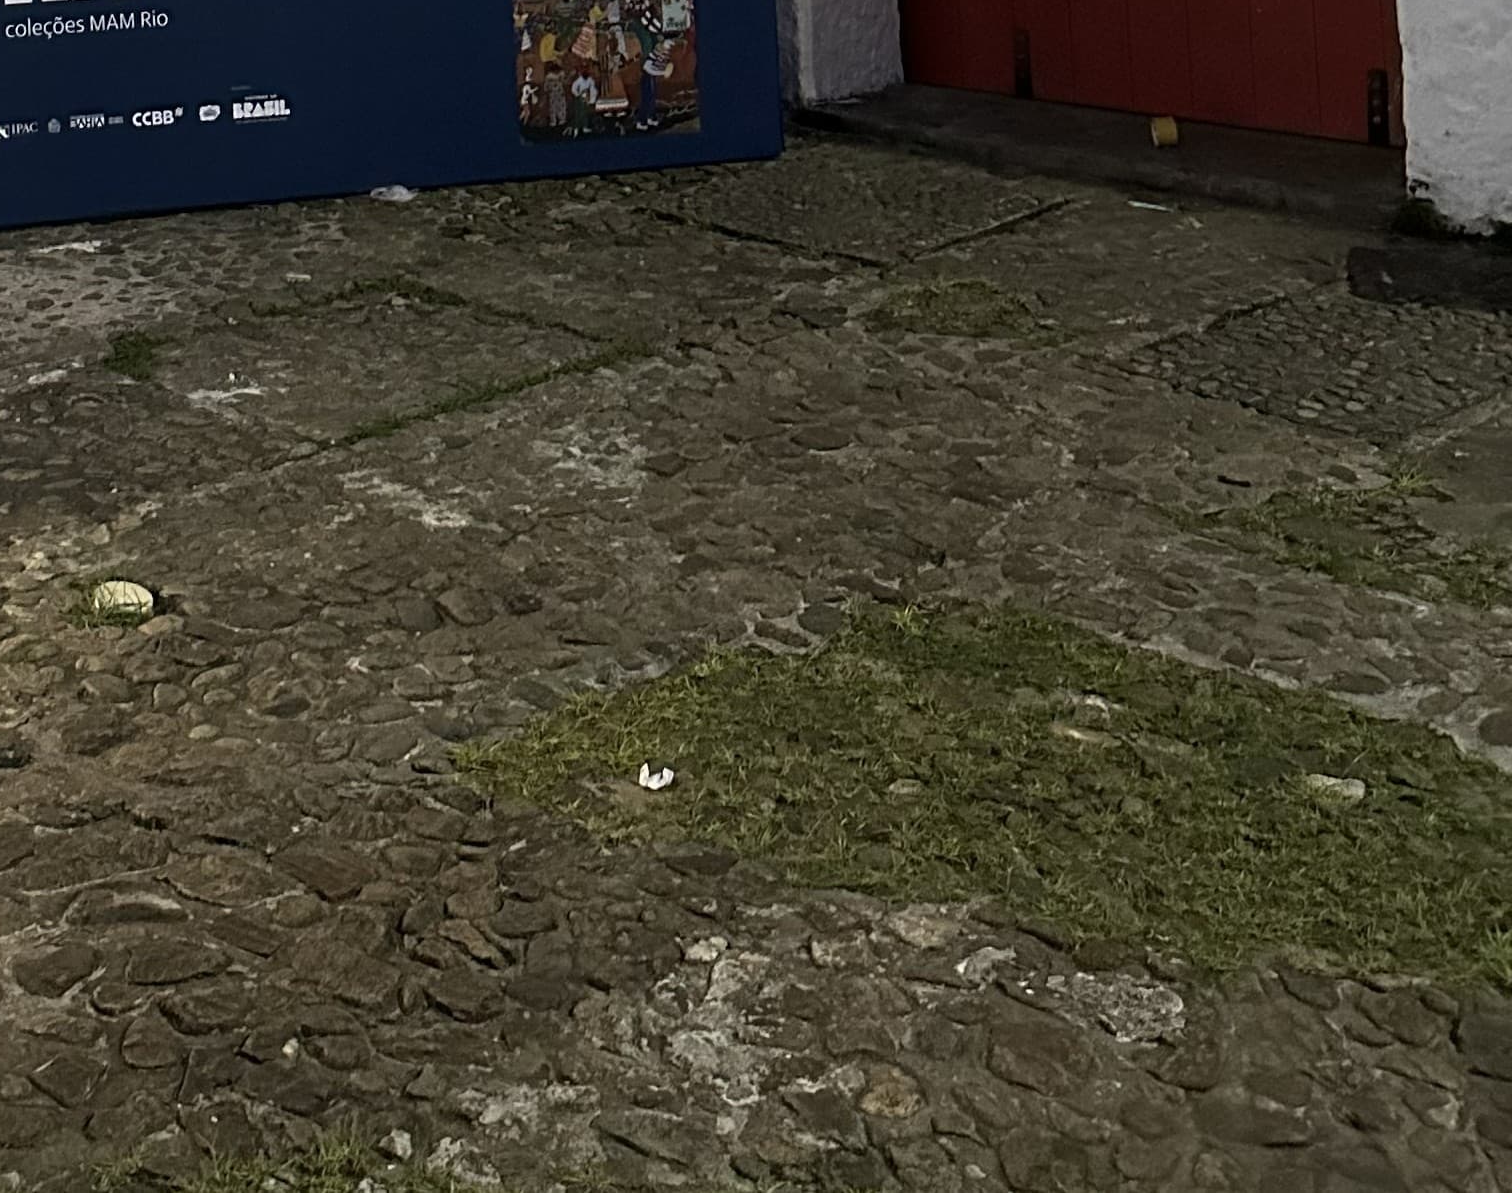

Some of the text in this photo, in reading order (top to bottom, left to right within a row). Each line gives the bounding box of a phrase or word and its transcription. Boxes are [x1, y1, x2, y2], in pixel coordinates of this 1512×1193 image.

[4, 10, 169, 39] coleções MAM Rio
[132, 109, 176, 127] CCBB
[232, 99, 291, 120] BRASIL
[11, 121, 38, 135] IPAC
